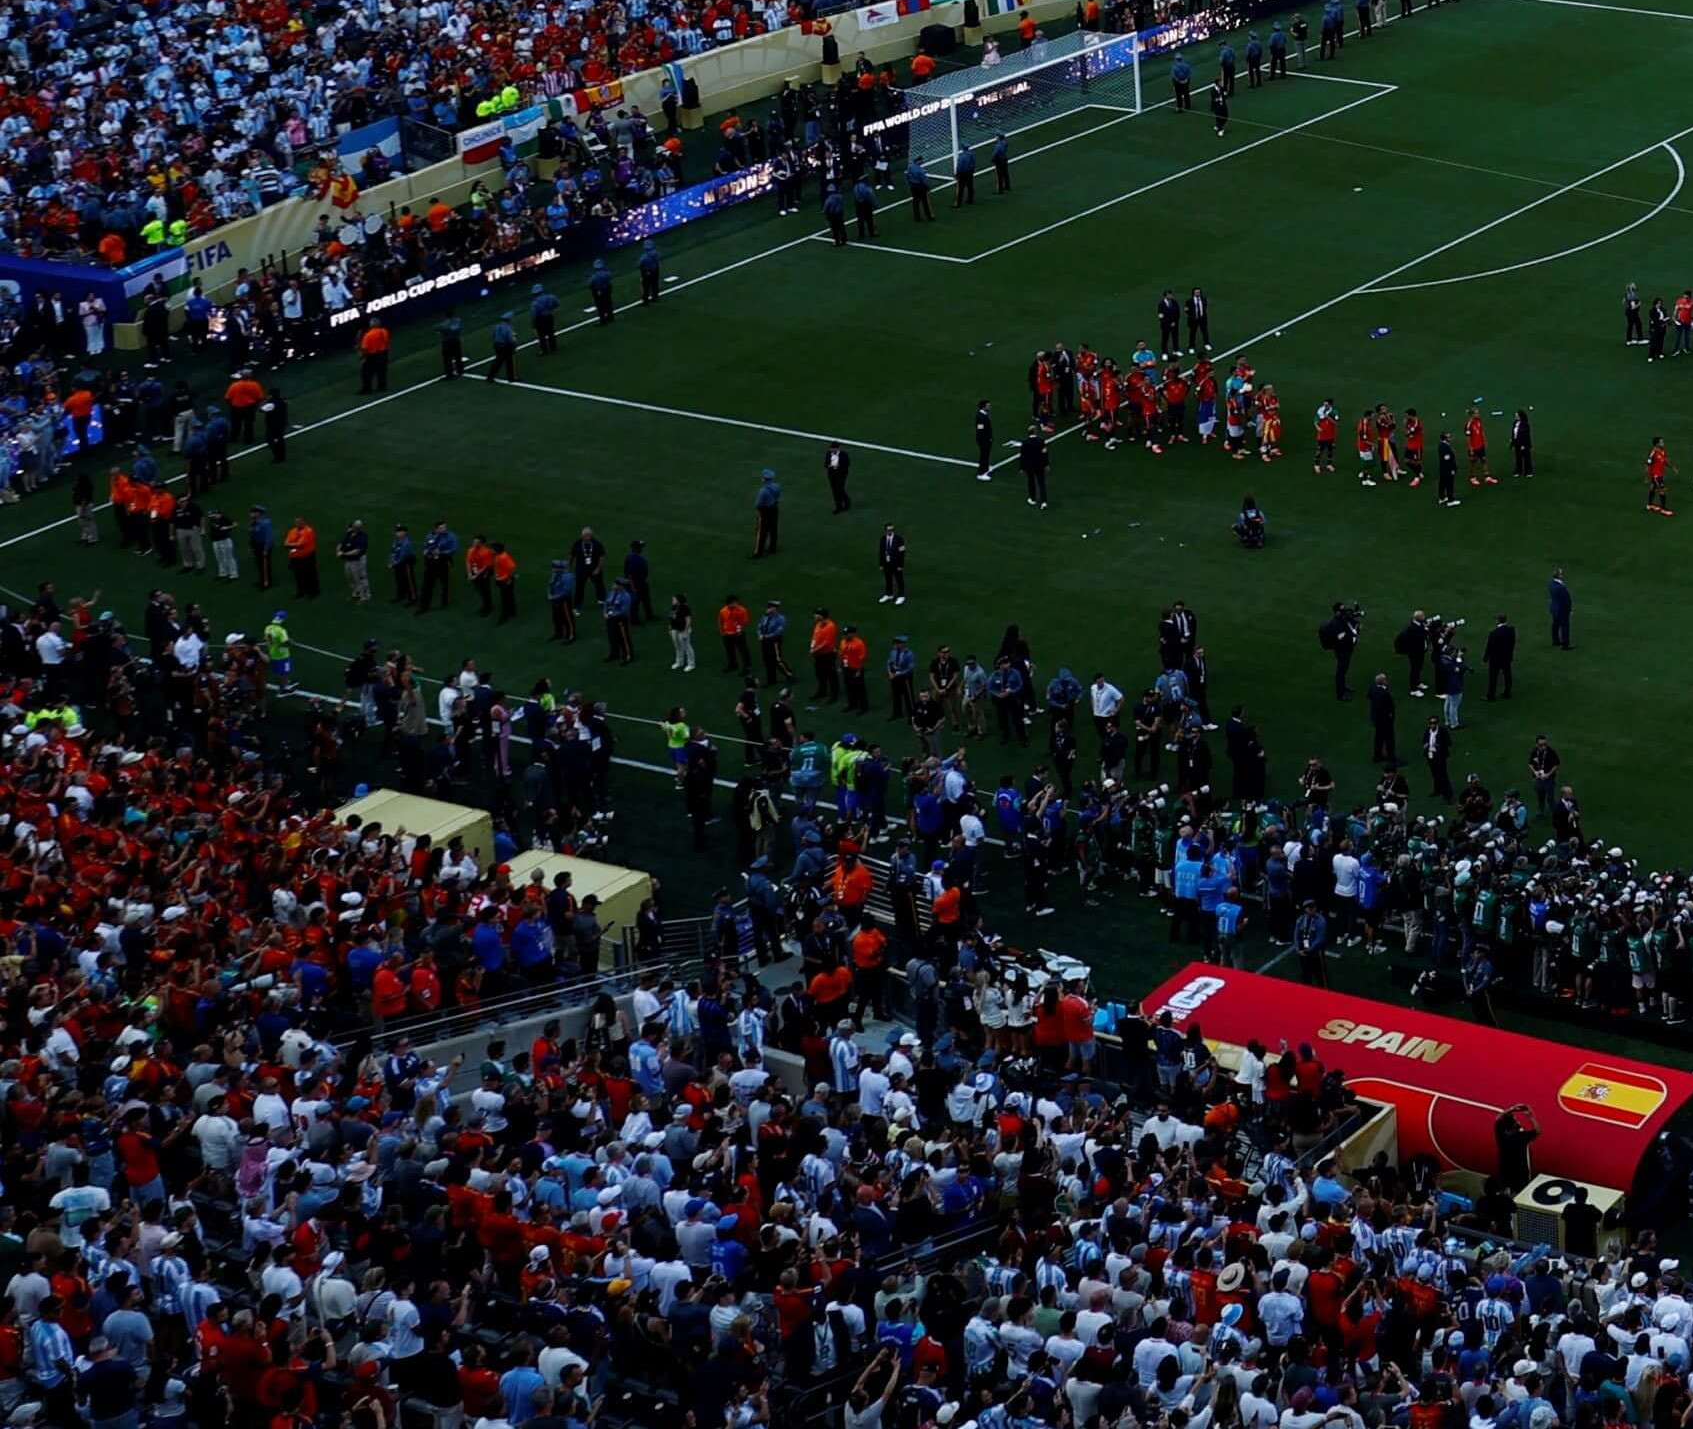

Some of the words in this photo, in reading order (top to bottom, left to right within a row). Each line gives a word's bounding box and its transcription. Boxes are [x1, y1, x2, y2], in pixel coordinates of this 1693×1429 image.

[186, 240, 232, 275] FIFA
[485, 262, 516, 282] THE
[330, 306, 360, 328] FIFA
[408, 281, 435, 300] CUP
[435, 264, 481, 289] 2026
[1318, 1018, 1453, 1064] SPAIN
